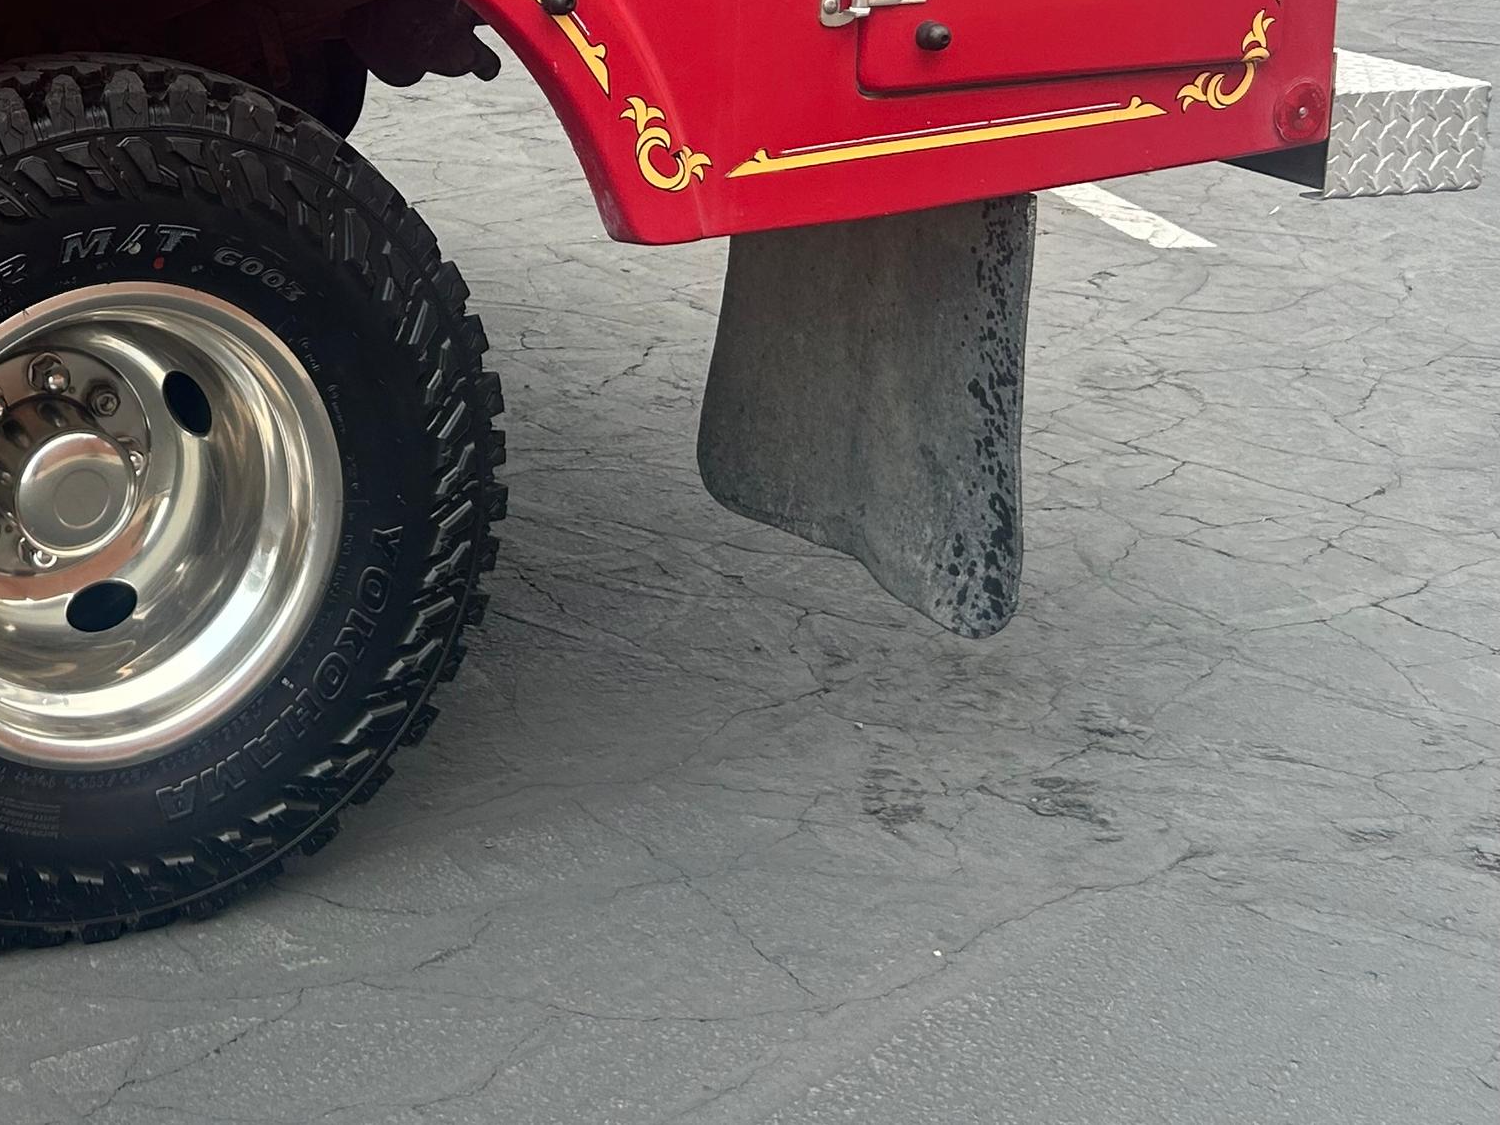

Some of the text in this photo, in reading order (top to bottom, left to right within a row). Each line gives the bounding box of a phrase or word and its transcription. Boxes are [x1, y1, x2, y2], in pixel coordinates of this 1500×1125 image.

[60, 223, 201, 265] M/T
[212, 245, 307, 303] G003
[155, 525, 404, 821] YOKOHAMA
